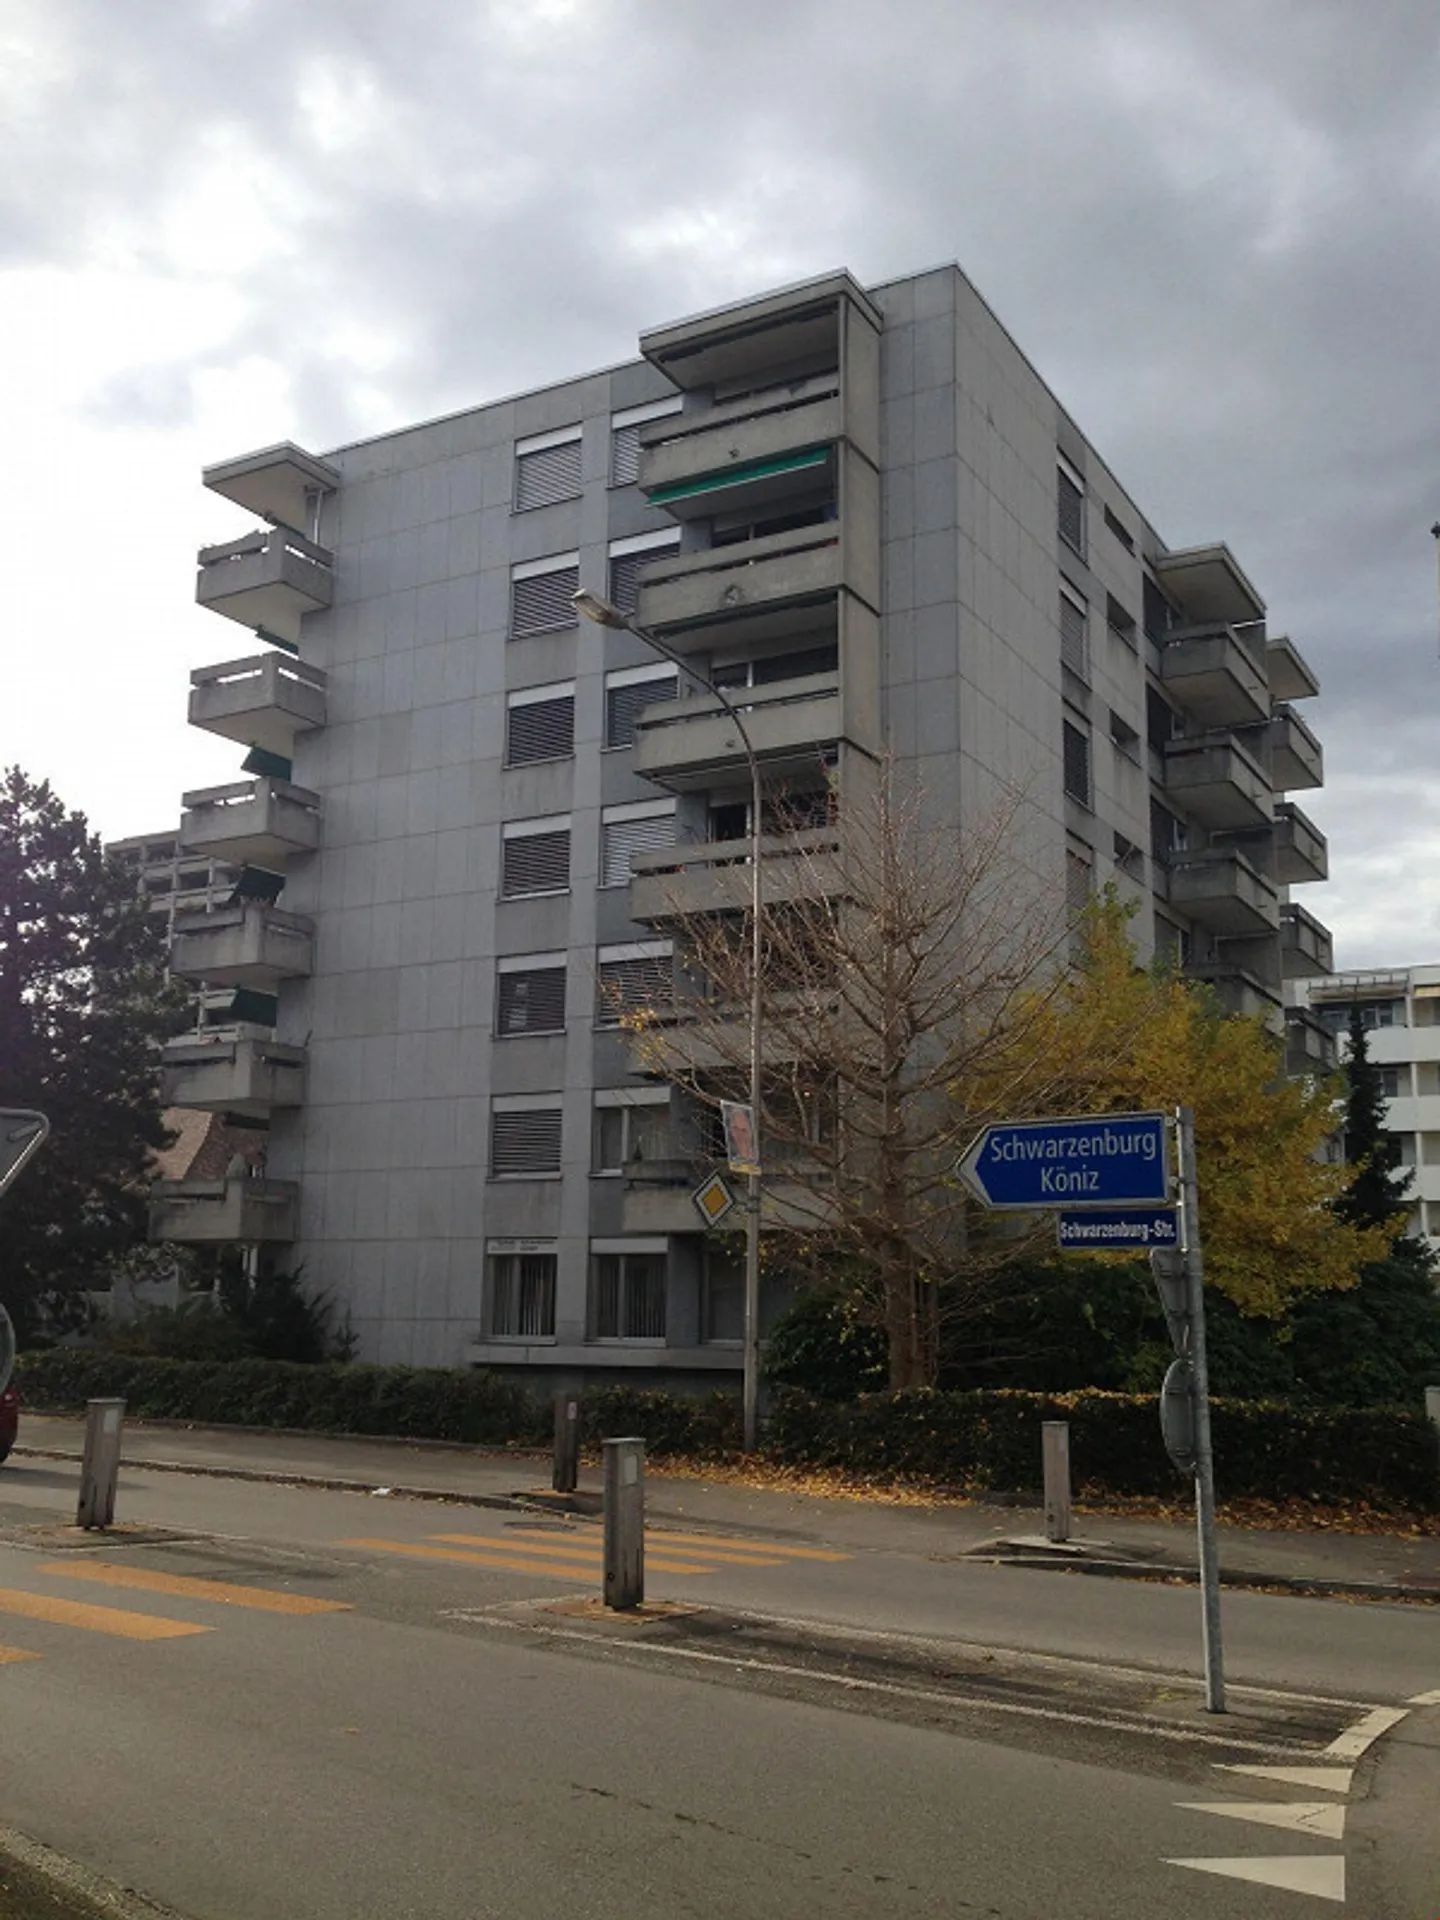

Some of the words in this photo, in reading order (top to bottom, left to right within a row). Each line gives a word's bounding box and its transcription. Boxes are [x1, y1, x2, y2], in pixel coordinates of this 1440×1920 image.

[990, 1129, 1156, 1161] Schwarzenburg
[1041, 1164, 1100, 1192] Köniz
[1060, 1219, 1175, 1241] Schwarzenburg-Str.
